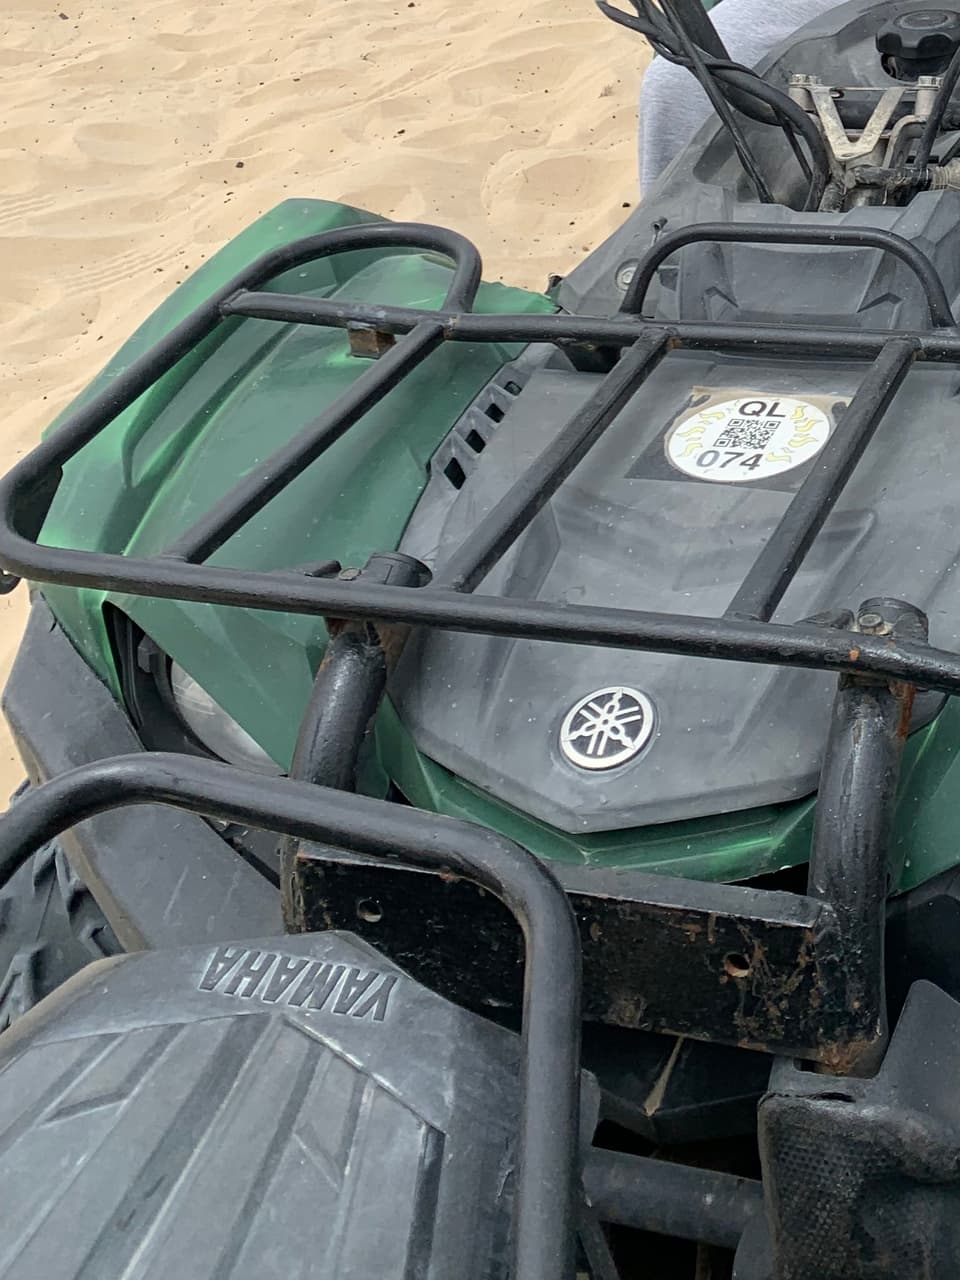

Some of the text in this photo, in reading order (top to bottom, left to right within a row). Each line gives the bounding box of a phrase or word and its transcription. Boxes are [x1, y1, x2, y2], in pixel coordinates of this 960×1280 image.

[738, 400, 787, 418] QL
[696, 450, 765, 471] 074
[198, 946, 399, 1022] YAMAHA
